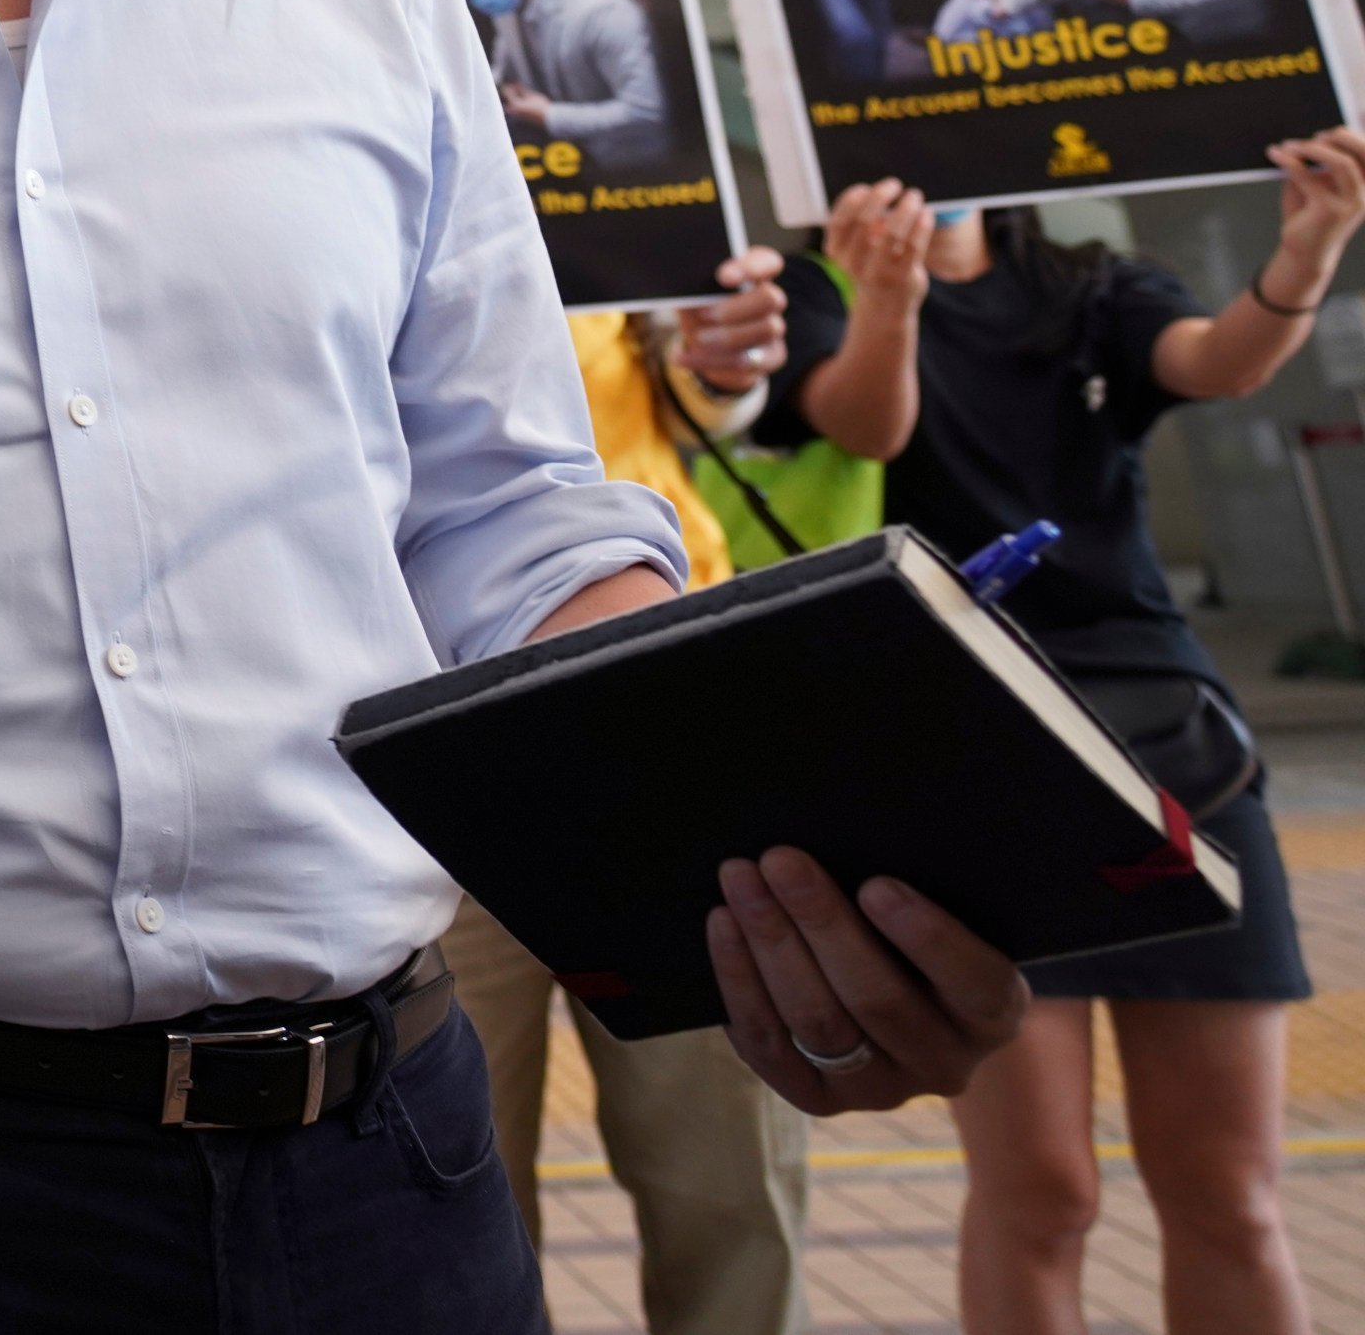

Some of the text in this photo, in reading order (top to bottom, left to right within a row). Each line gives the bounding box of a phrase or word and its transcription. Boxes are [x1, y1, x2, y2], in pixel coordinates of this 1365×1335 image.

[925, 16, 1168, 82] Injustice
[811, 46, 1319, 127] the Accuser becomes the Accused
[538, 176, 717, 215] the Accused
